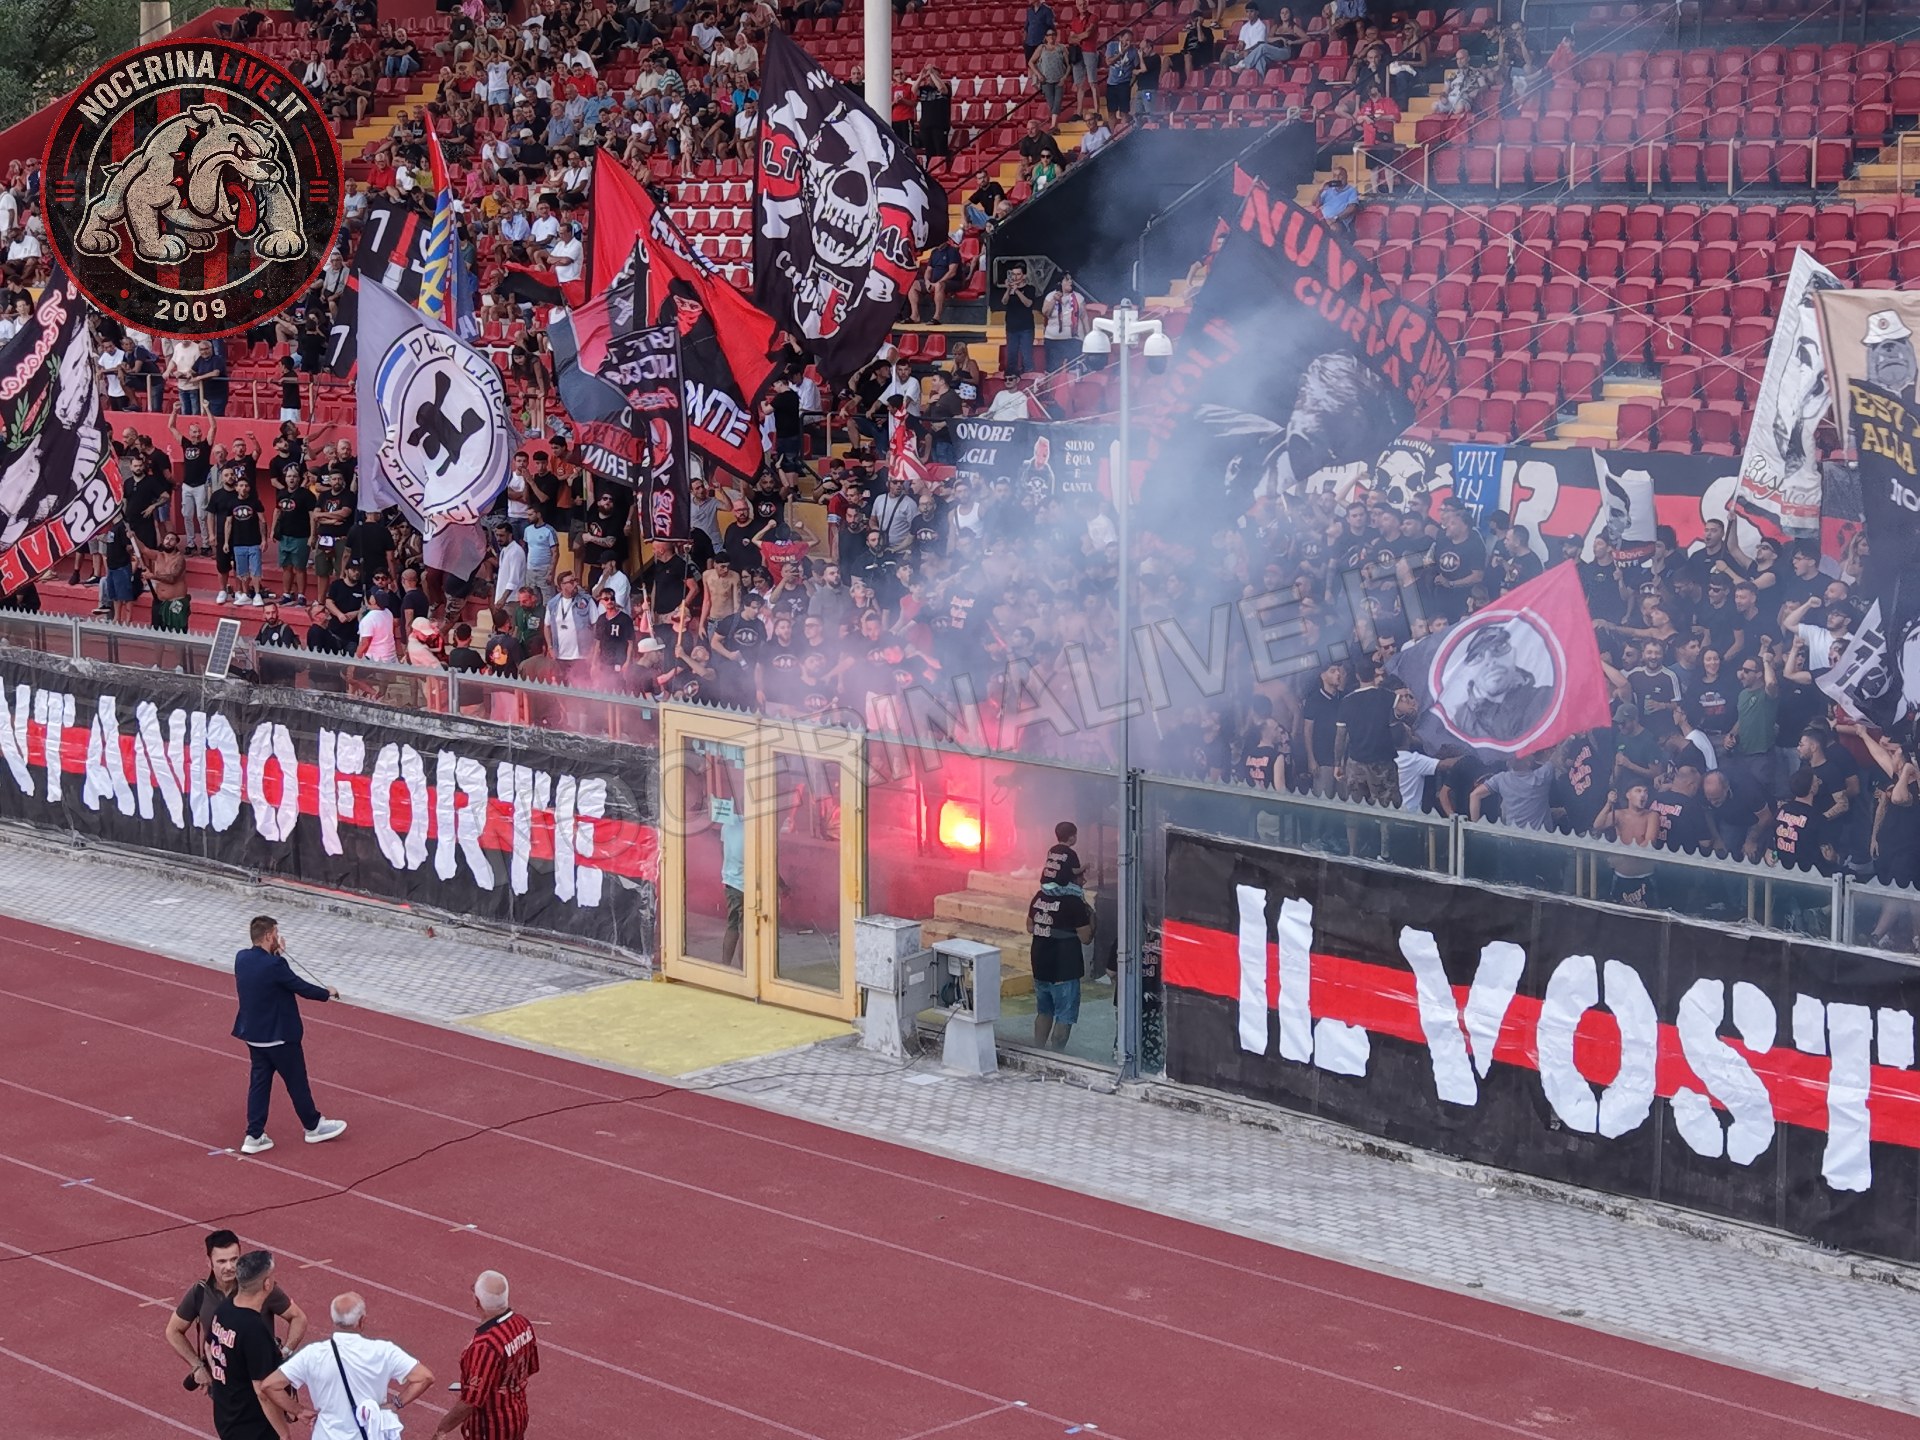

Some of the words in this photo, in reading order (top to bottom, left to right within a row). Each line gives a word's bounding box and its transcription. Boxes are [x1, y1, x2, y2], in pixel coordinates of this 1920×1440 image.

[956, 423, 1015, 442] ONORE
[1064, 440, 1095, 452] SILVIO
[1073, 457, 1092, 467] QUA
[1458, 450, 1497, 477] VIVI
[1062, 481, 1094, 493] CANTA
[1456, 477, 1483, 501] IN
[611, 624, 620, 637] H
[318, 726, 607, 908] FORTE
[1650, 800, 1683, 817] Angeli
[1776, 809, 1808, 829] Angeli
[1776, 824, 1799, 841] della
[1777, 837, 1796, 854] Sud
[1236, 883, 1372, 1079] IL
[1400, 925, 1916, 1193] VOST
